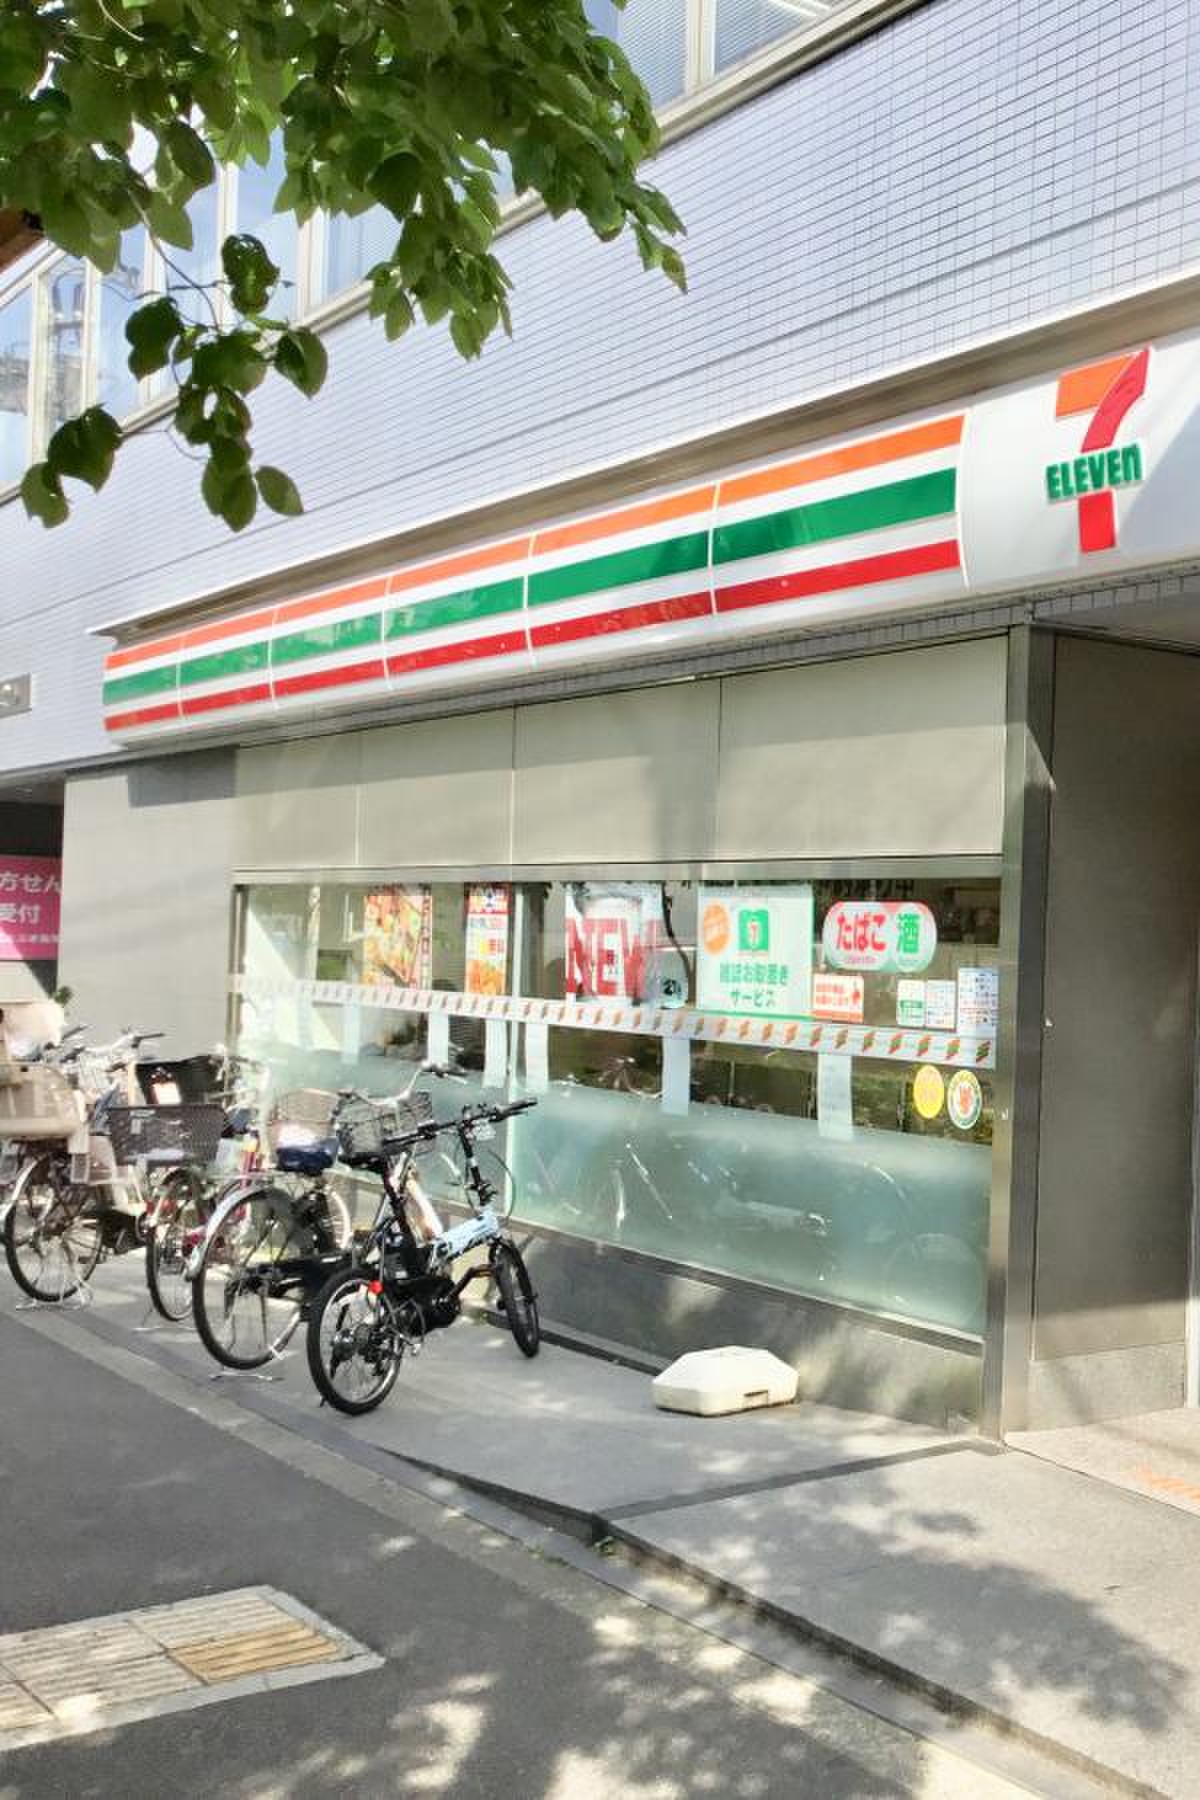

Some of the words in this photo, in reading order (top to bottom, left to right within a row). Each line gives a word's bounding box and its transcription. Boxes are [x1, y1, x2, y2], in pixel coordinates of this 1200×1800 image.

[1055, 346, 1151, 554] 7
[836, 912, 887, 952] たばこ
[896, 913, 920, 953] 酒
